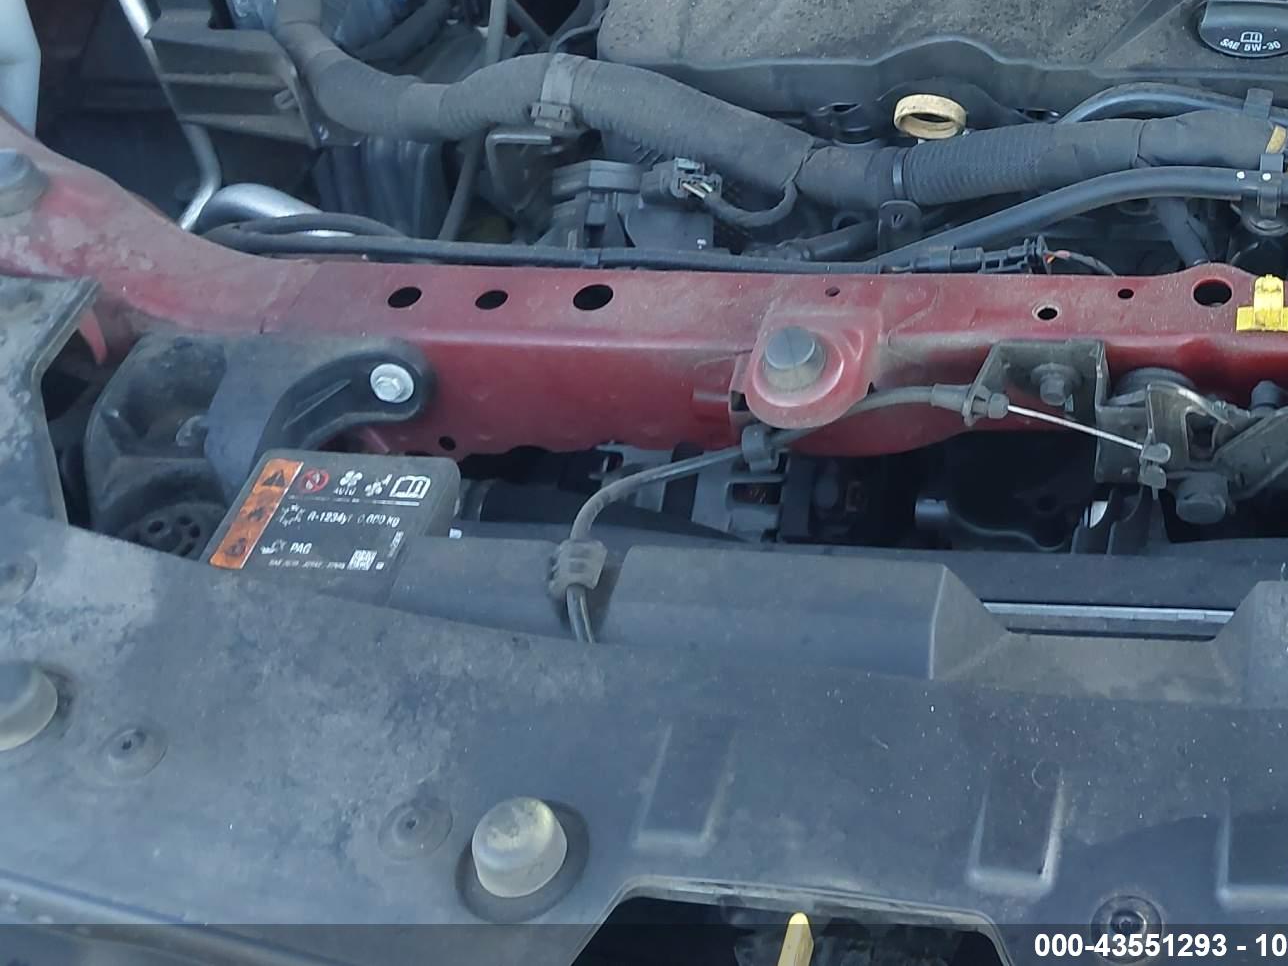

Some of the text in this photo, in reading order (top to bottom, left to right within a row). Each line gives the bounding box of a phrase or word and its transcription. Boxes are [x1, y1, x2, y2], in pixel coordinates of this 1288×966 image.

[1220, 38, 1281, 52] SAE 5W-30
[289, 542, 313, 555] PAG
